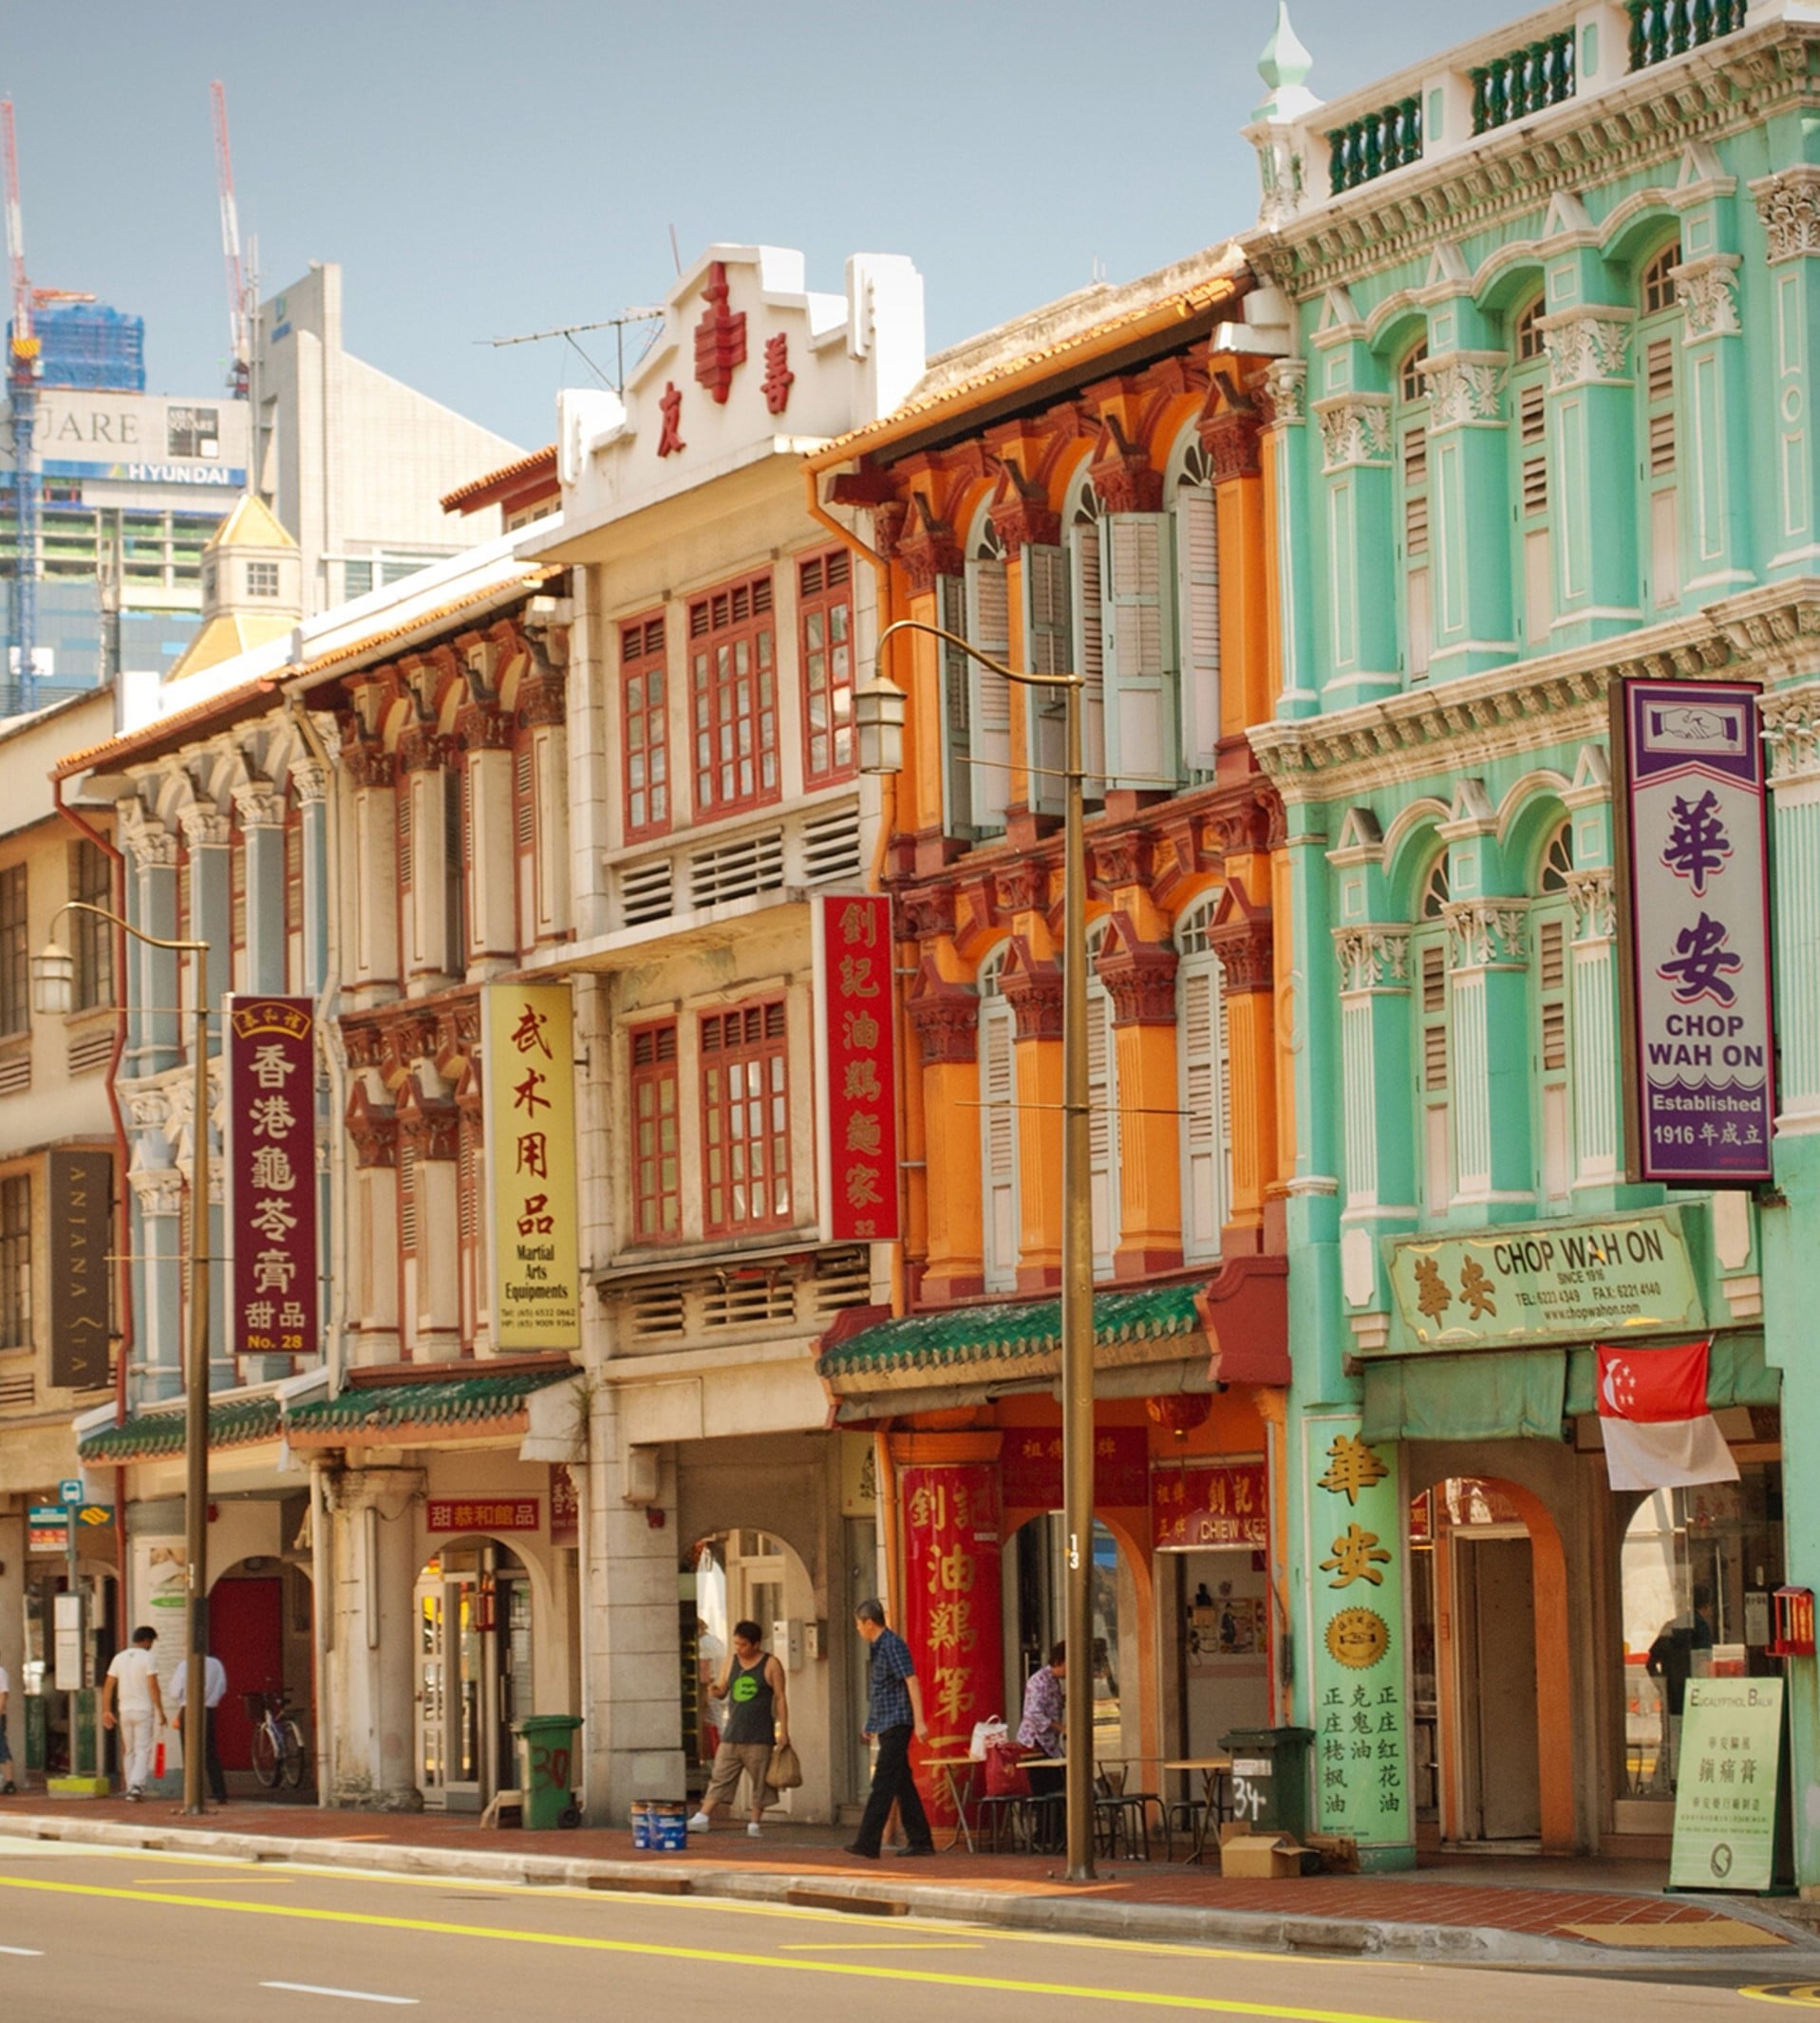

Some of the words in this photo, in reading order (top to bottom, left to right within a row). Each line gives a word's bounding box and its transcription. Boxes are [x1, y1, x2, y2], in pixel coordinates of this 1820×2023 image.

[128, 463, 230, 485] HYUNDAI
[1665, 1014, 1745, 1039] CHOP
[1648, 1042, 1711, 1068] WAH
[1722, 1044, 1764, 1069] ON
[1652, 1094, 1762, 1113] Established
[1653, 1124, 1696, 1145] 1916
[1698, 1121, 1763, 1147] 年成立
[68, 1167, 86, 1298] ANJANA
[854, 1219, 876, 1236] 32
[516, 1244, 554, 1262] Martial
[1493, 1240, 1554, 1275] CHOP
[1559, 1233, 1623, 1269] WAH
[1625, 1229, 1664, 1264] ON
[525, 1263, 548, 1281] Arts
[1556, 1270, 1585, 1285] SINCE
[504, 1282, 569, 1303] Equipments
[1591, 1285, 1616, 1301] FAX:
[245, 1302, 306, 1329] 甜品
[248, 1334, 276, 1349] No.
[281, 1334, 304, 1349] 28
[1200, 1519, 1239, 1540] CHIEW
[1232, 1777, 1266, 1821] 34
